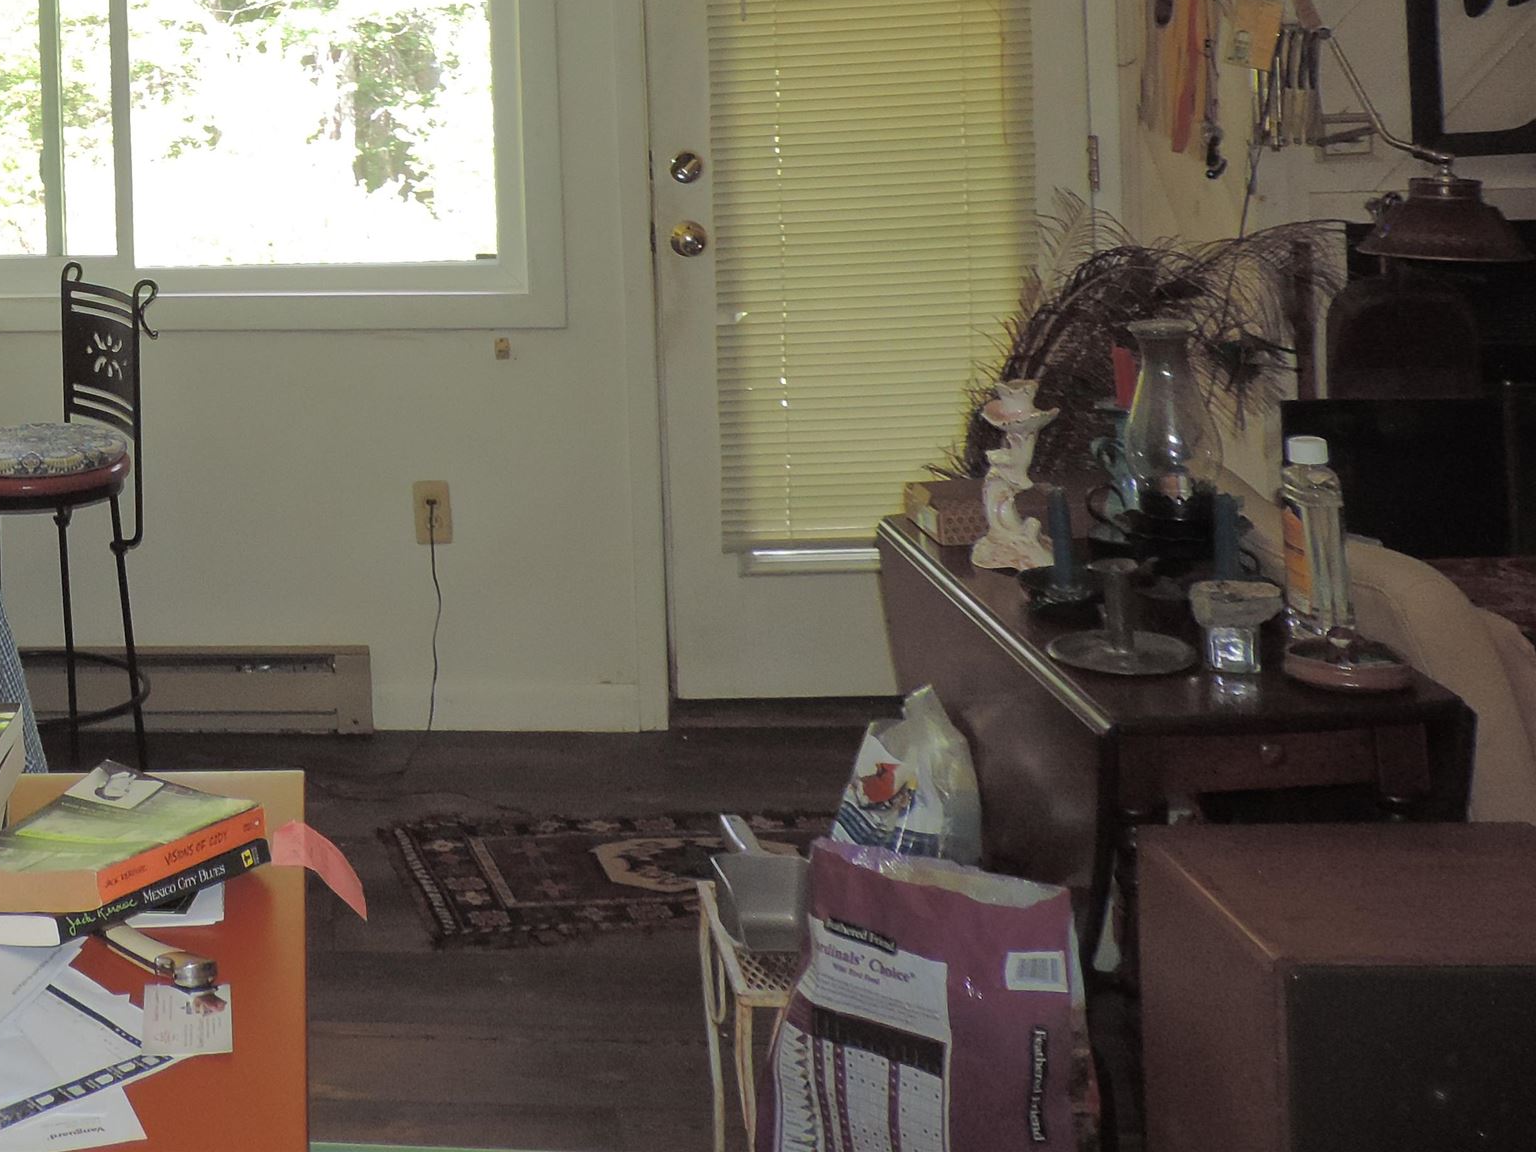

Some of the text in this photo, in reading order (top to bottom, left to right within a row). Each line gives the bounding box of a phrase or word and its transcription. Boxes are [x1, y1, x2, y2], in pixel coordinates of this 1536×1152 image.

[164, 831, 228, 866] VISIONS OF CODY
[142, 884, 177, 904] MEXICO
[198, 864, 226, 883] BLUES
[65, 898, 139, 936] Jack Kerouac
